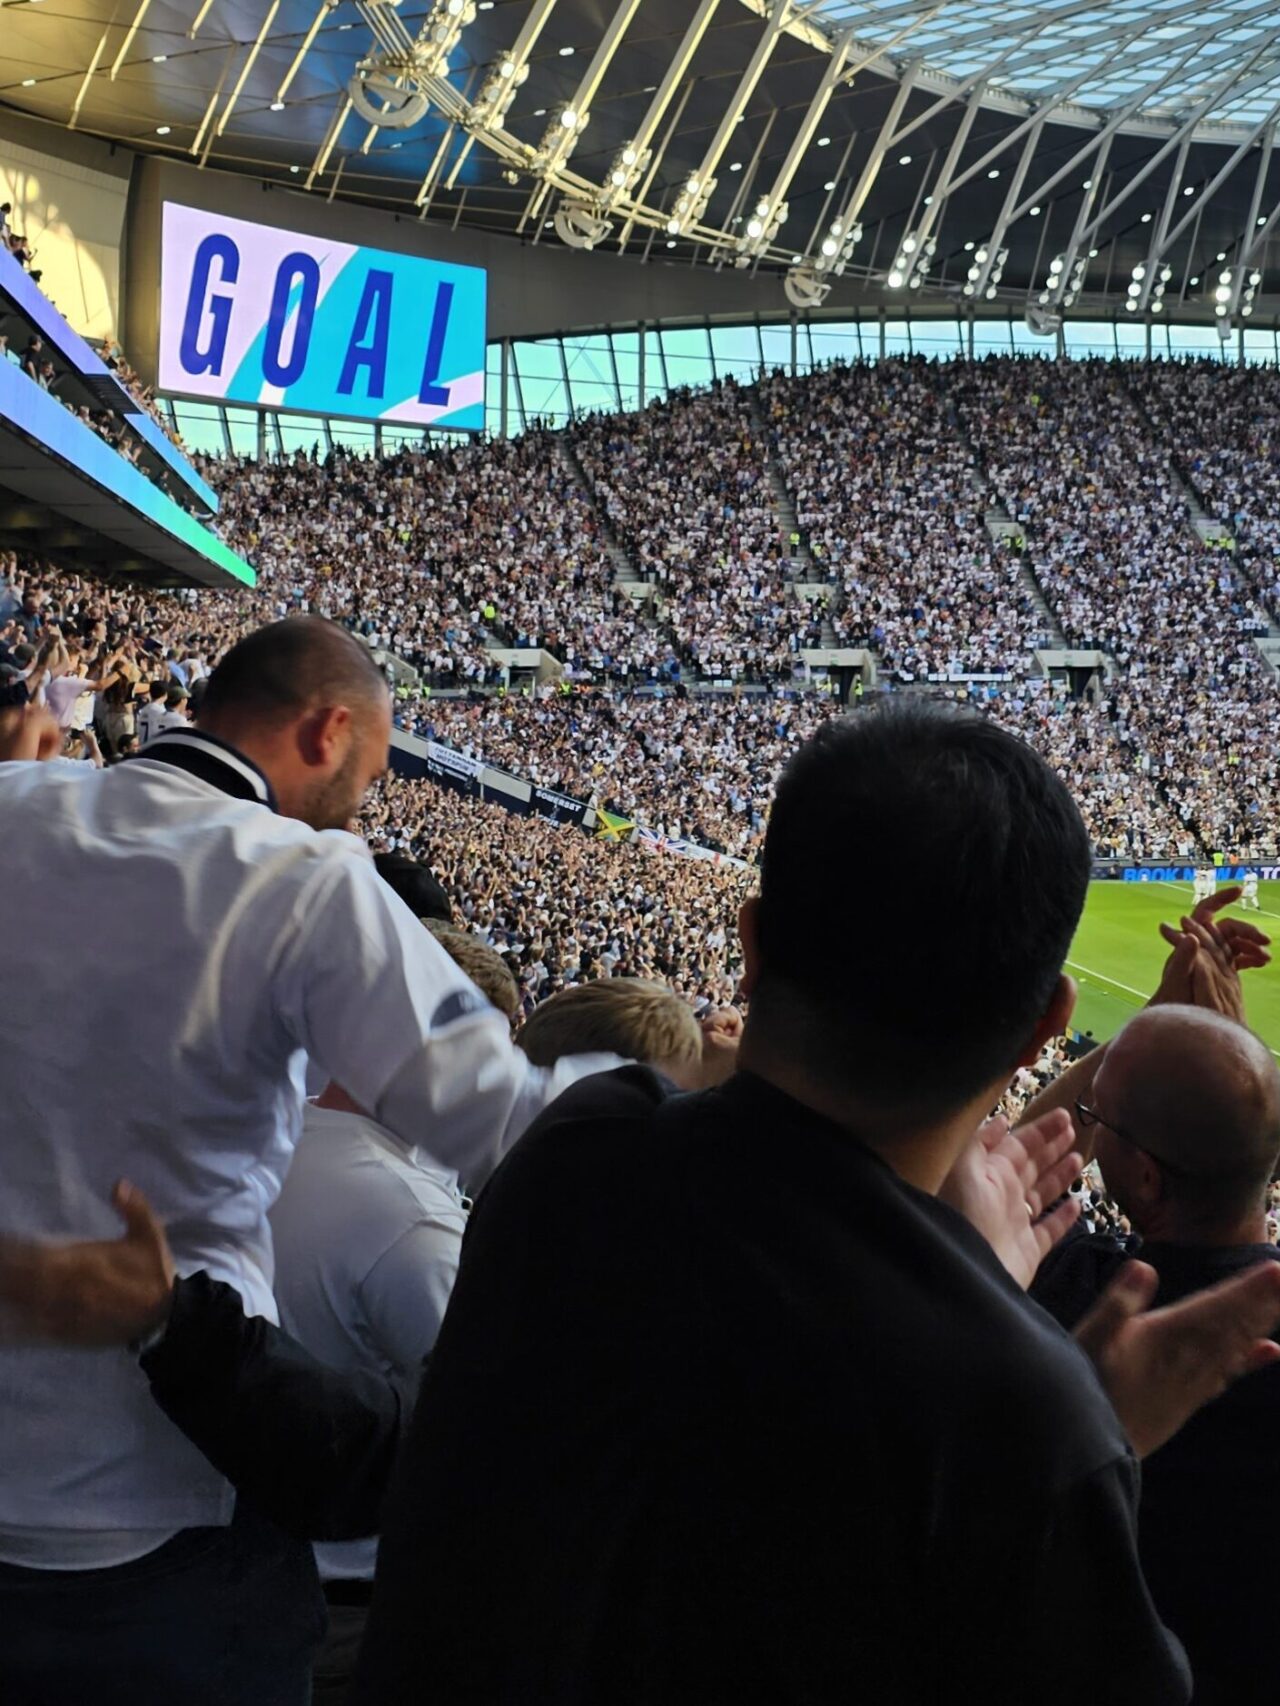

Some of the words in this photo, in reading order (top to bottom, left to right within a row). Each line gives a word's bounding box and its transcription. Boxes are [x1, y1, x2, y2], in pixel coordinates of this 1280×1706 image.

[180, 234, 454, 406] GOAL
[1124, 866, 1179, 882] BOOK
[1183, 866, 1231, 881] NW
